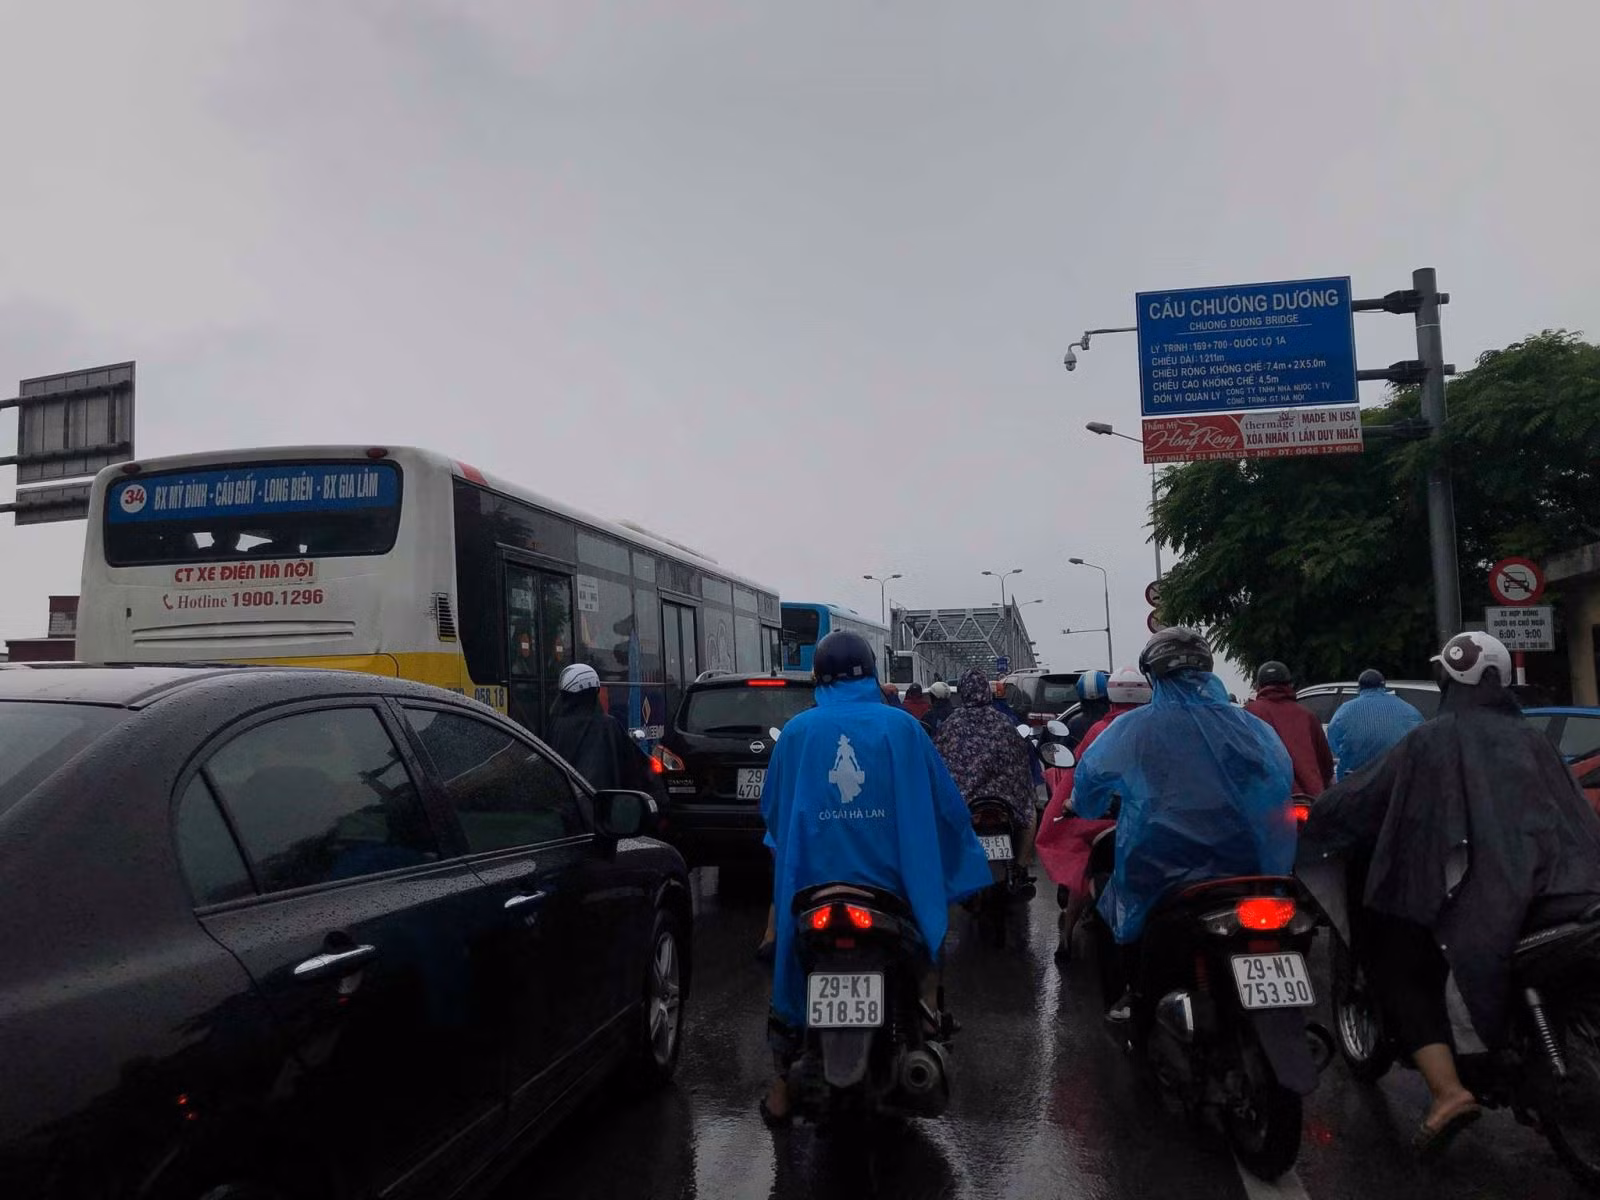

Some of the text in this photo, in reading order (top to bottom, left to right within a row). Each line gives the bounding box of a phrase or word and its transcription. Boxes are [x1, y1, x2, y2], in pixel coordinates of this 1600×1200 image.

[1149, 289, 1339, 320] CẦU CHƯƠNG DƯƠNG
[1230, 317, 1263, 328] DUONG
[1265, 314, 1299, 325] BRIDGE
[1276, 336, 1287, 346] 1A
[1181, 379, 1200, 389] CAO
[1302, 411, 1357, 424] MADE IN USA
[1317, 430, 1334, 441] DUY
[125, 488, 144, 505] 34
[154, 485, 168, 510] BX
[235, 472, 257, 504] GIẤY
[264, 477, 289, 503] LONG
[290, 470, 313, 501] BIÊN
[323, 473, 338, 499] BX
[338, 473, 355, 499] GIA
[357, 467, 379, 498] LÂM
[175, 568, 194, 583] CT
[197, 566, 216, 582] XE
[177, 589, 324, 609] Hotline 1900.1296
[1499, 629, 1516, 639] 6:00
[1524, 629, 1542, 639] 9:00
[865, 808, 886, 818] LAN
[818, 975, 871, 999] 29-K1
[1242, 980, 1309, 1005] 753.90
[812, 1000, 879, 1024] 518.58
